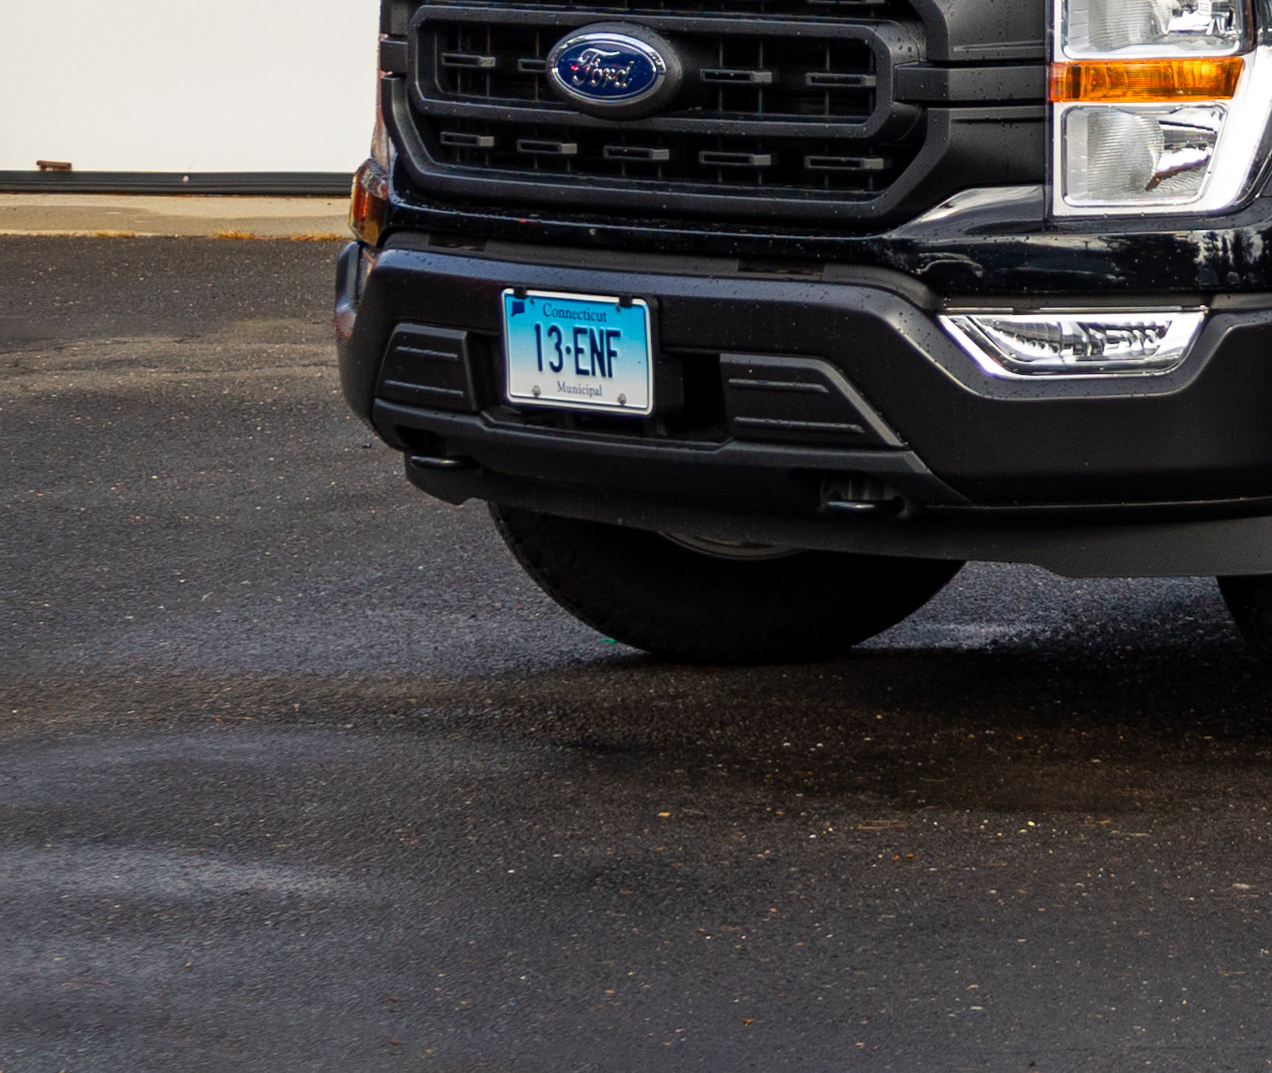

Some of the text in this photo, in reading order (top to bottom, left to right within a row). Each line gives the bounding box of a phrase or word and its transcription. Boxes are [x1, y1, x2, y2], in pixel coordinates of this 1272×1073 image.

[570, 47, 635, 88] Ford
[543, 302, 608, 323] Connecticut
[556, 380, 603, 398] Municipal
